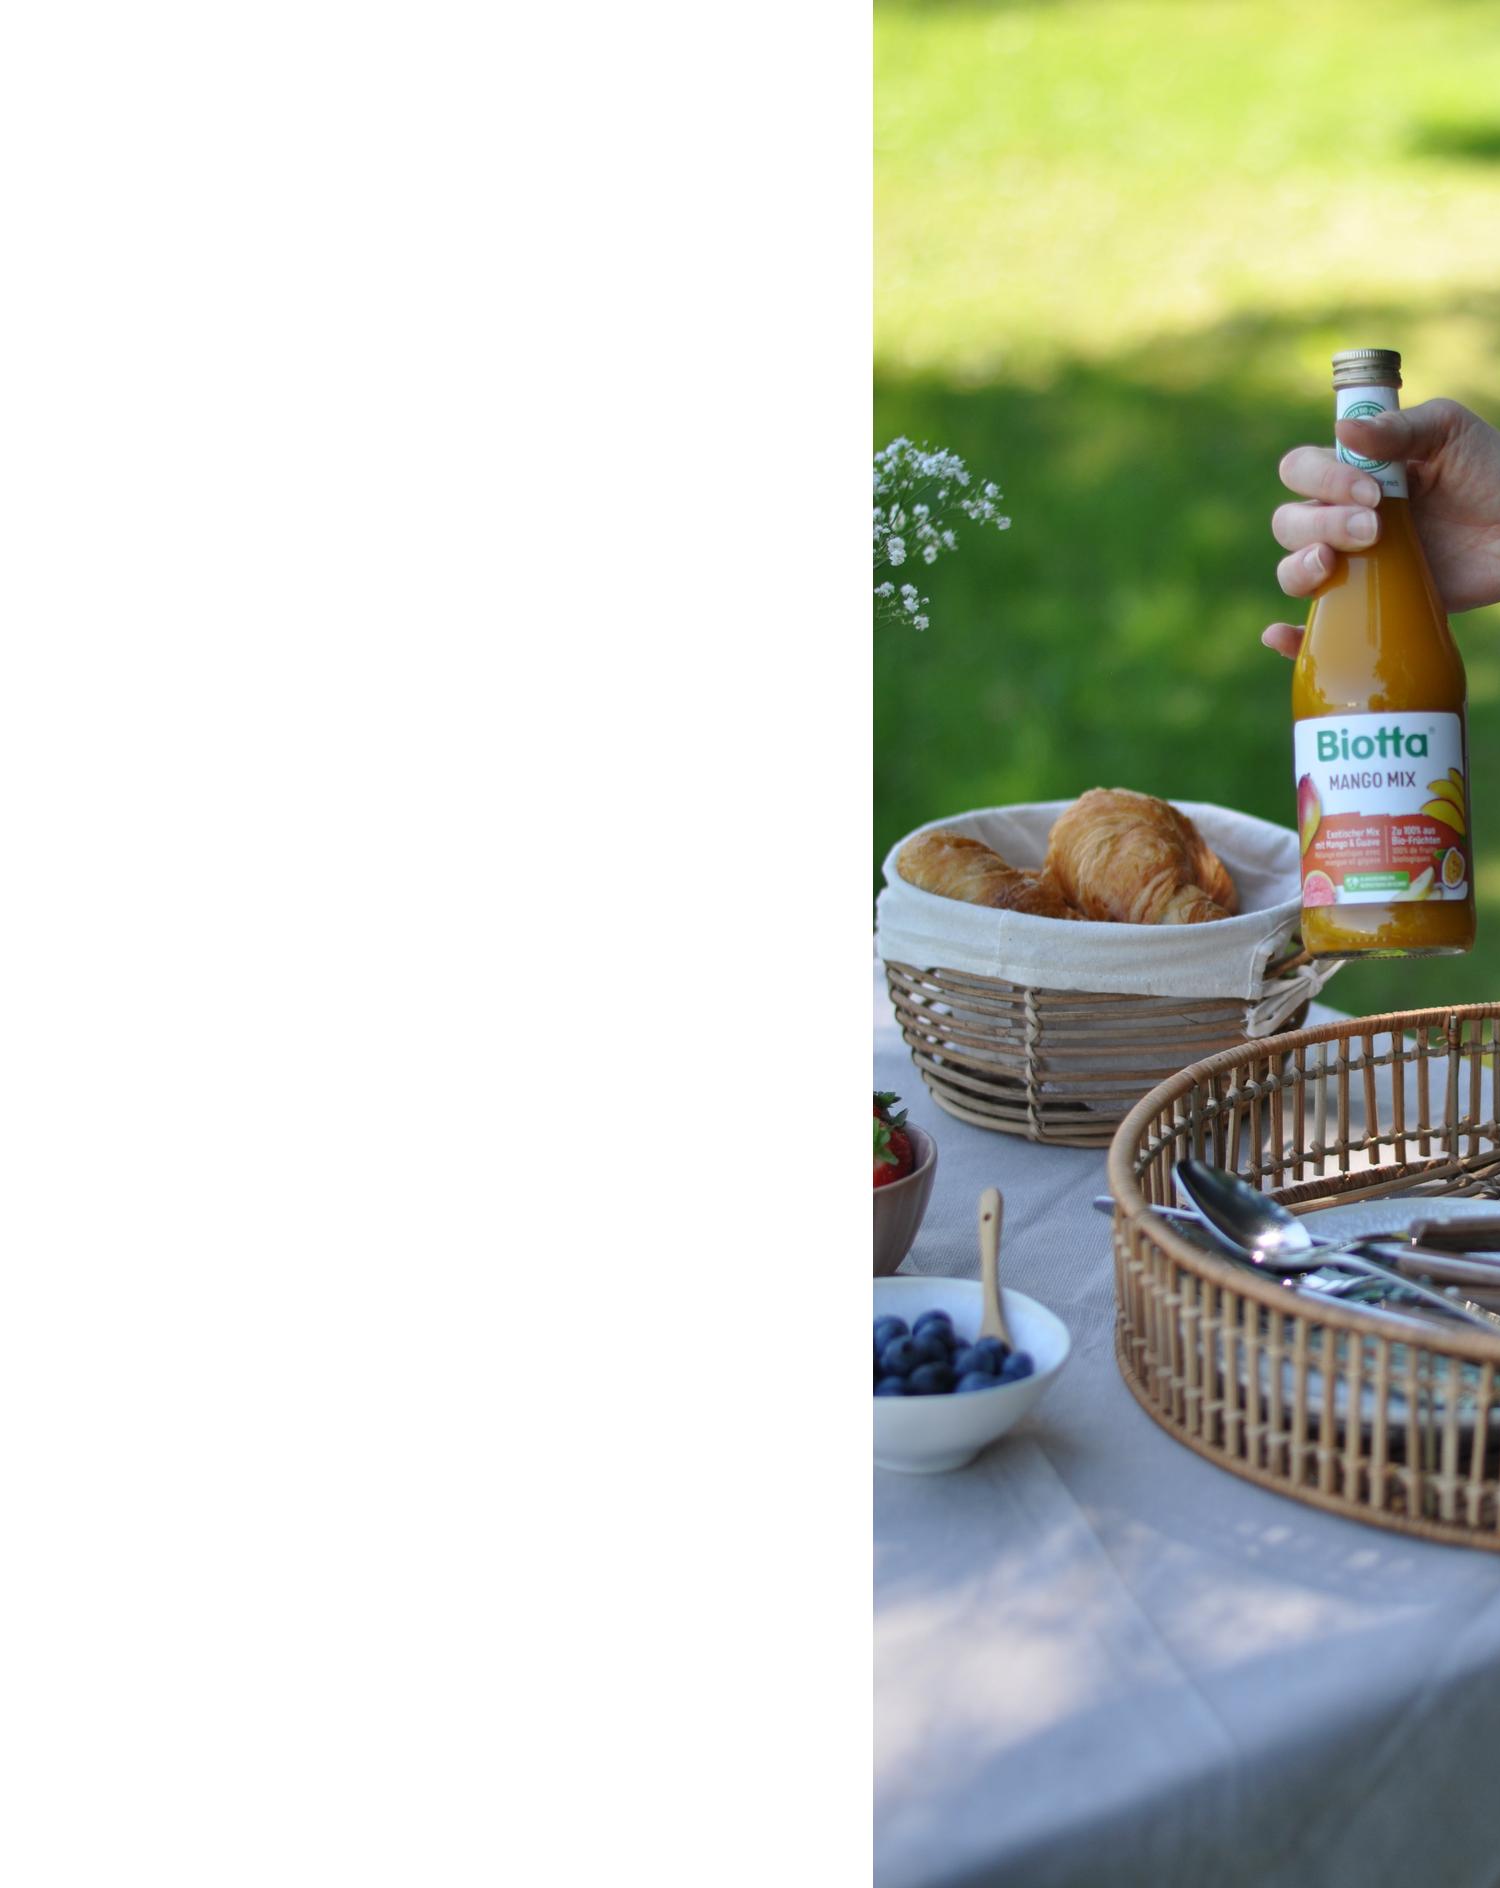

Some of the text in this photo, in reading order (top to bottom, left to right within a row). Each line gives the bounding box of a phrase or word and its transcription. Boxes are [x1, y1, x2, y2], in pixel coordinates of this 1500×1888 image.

[1317, 726, 1429, 763] Biotta
[1329, 771, 1417, 791] MANGO MIX
[1326, 840, 1348, 850] Mango
